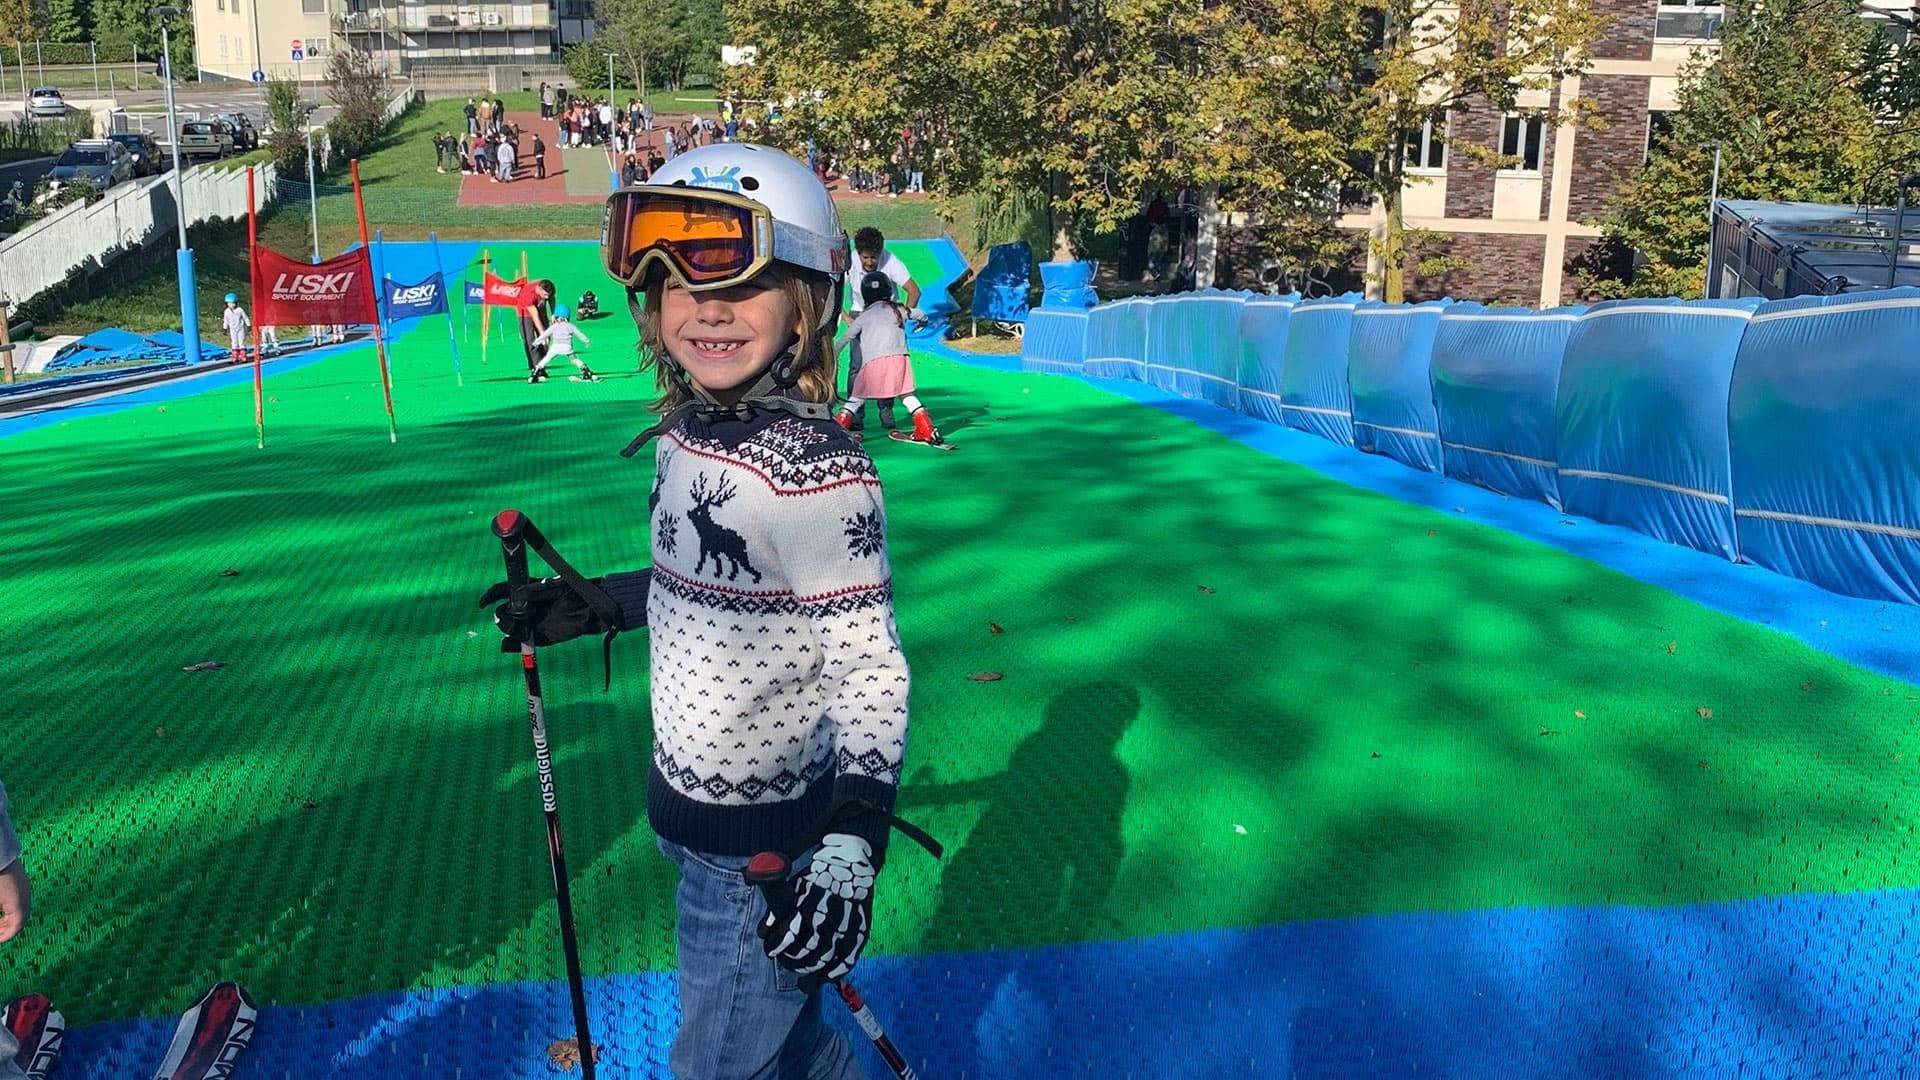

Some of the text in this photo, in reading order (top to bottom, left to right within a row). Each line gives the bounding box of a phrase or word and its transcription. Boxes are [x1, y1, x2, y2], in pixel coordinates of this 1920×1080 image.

[272, 271, 355, 293] LISKI
[392, 283, 435, 300] LISKI
[490, 283, 522, 298] LISKI
[272, 293, 346, 302] SPORT EQUIPMENT
[533, 728, 557, 813] ROSSIGNOL
[27, 1026, 65, 1080] NO
